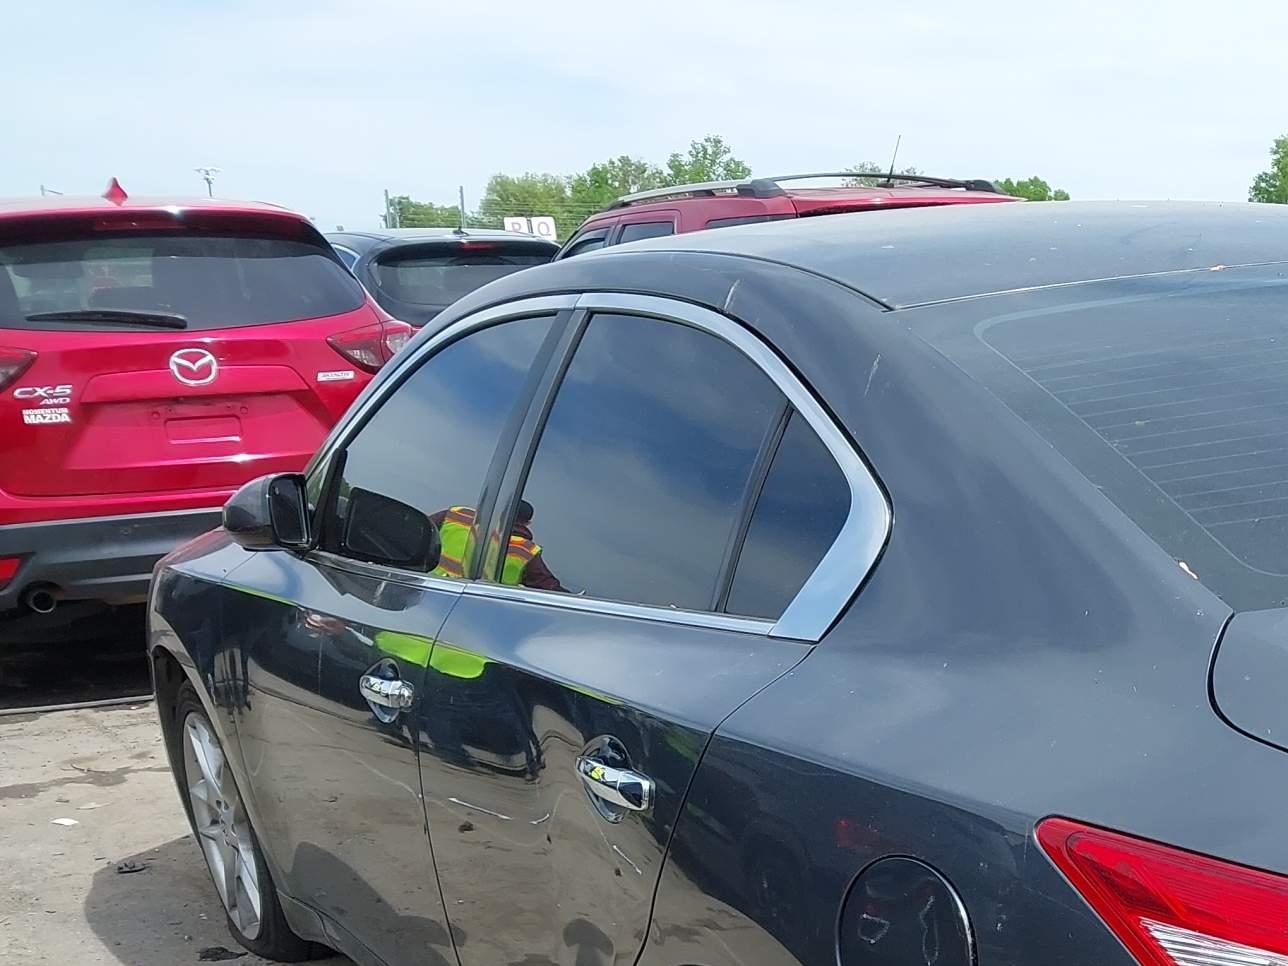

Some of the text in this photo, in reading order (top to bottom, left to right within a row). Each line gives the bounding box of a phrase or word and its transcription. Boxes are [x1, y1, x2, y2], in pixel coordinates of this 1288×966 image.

[13, 384, 73, 399] CX-5
[40, 397, 71, 405] AWD
[24, 413, 72, 425] MAZDA
